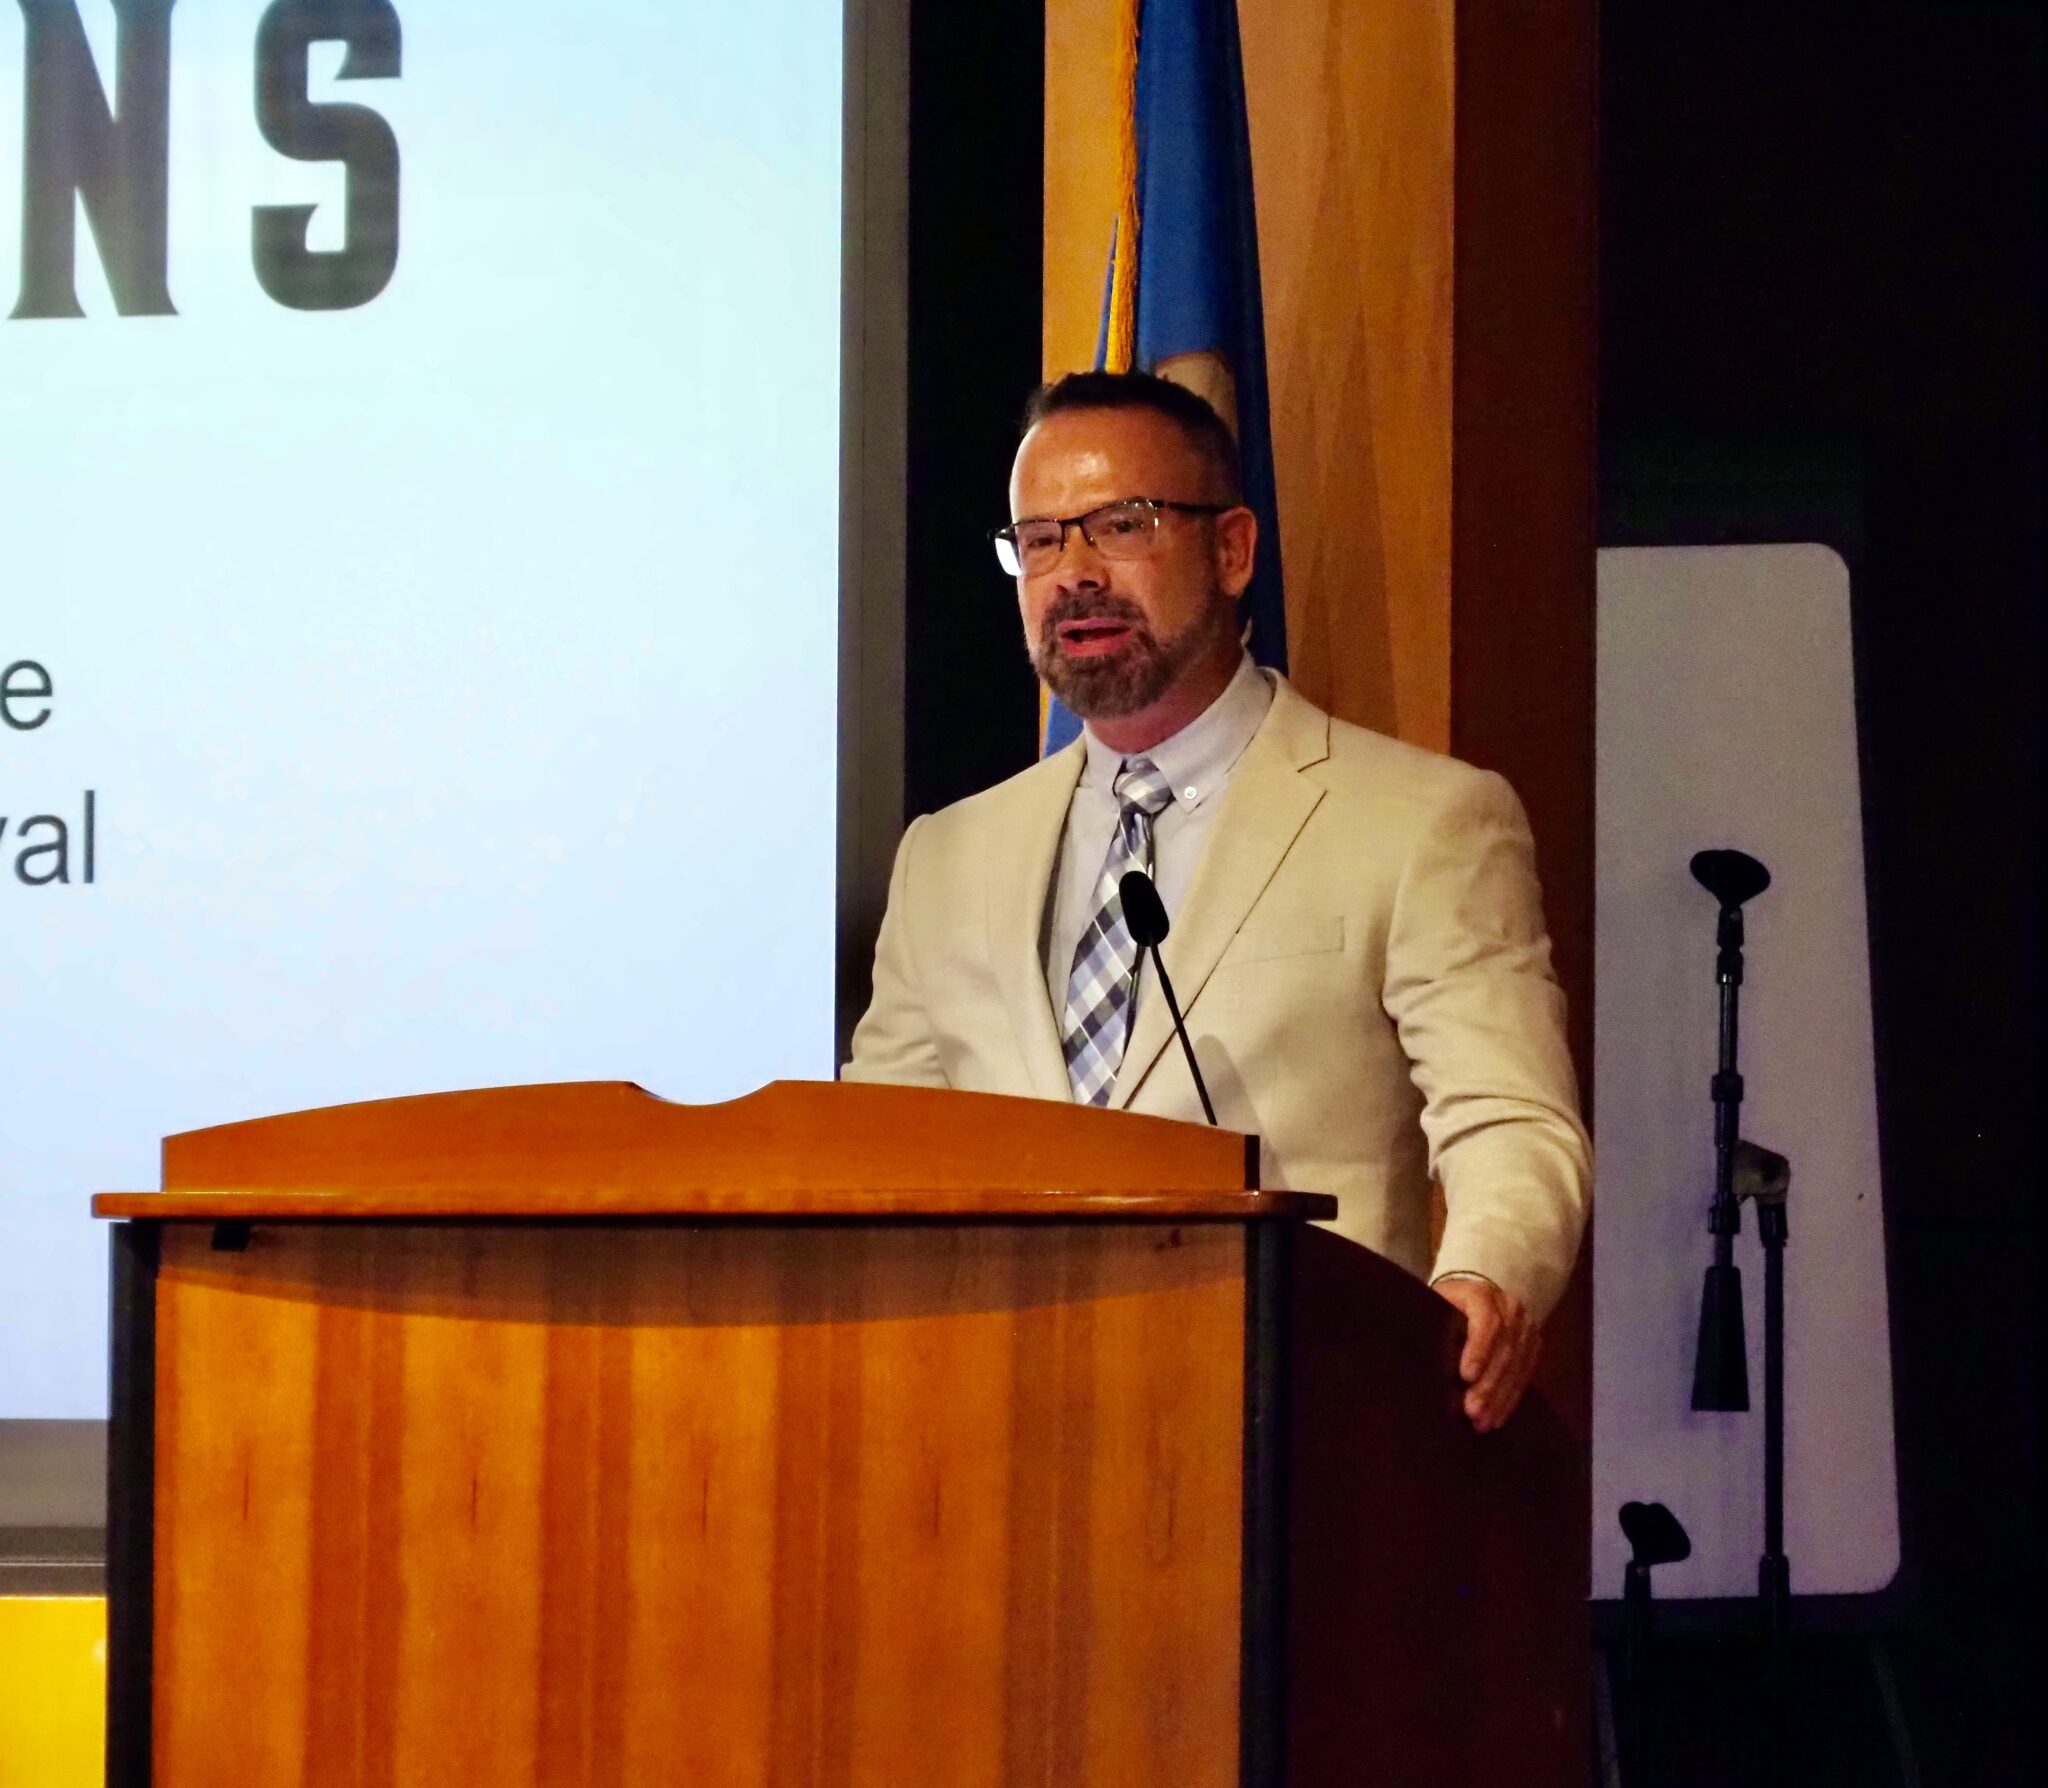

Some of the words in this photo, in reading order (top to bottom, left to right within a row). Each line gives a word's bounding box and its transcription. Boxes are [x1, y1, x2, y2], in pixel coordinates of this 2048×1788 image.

[8, 0, 402, 319] NS
[0, 660, 53, 731] e
[0, 789, 95, 886] al
